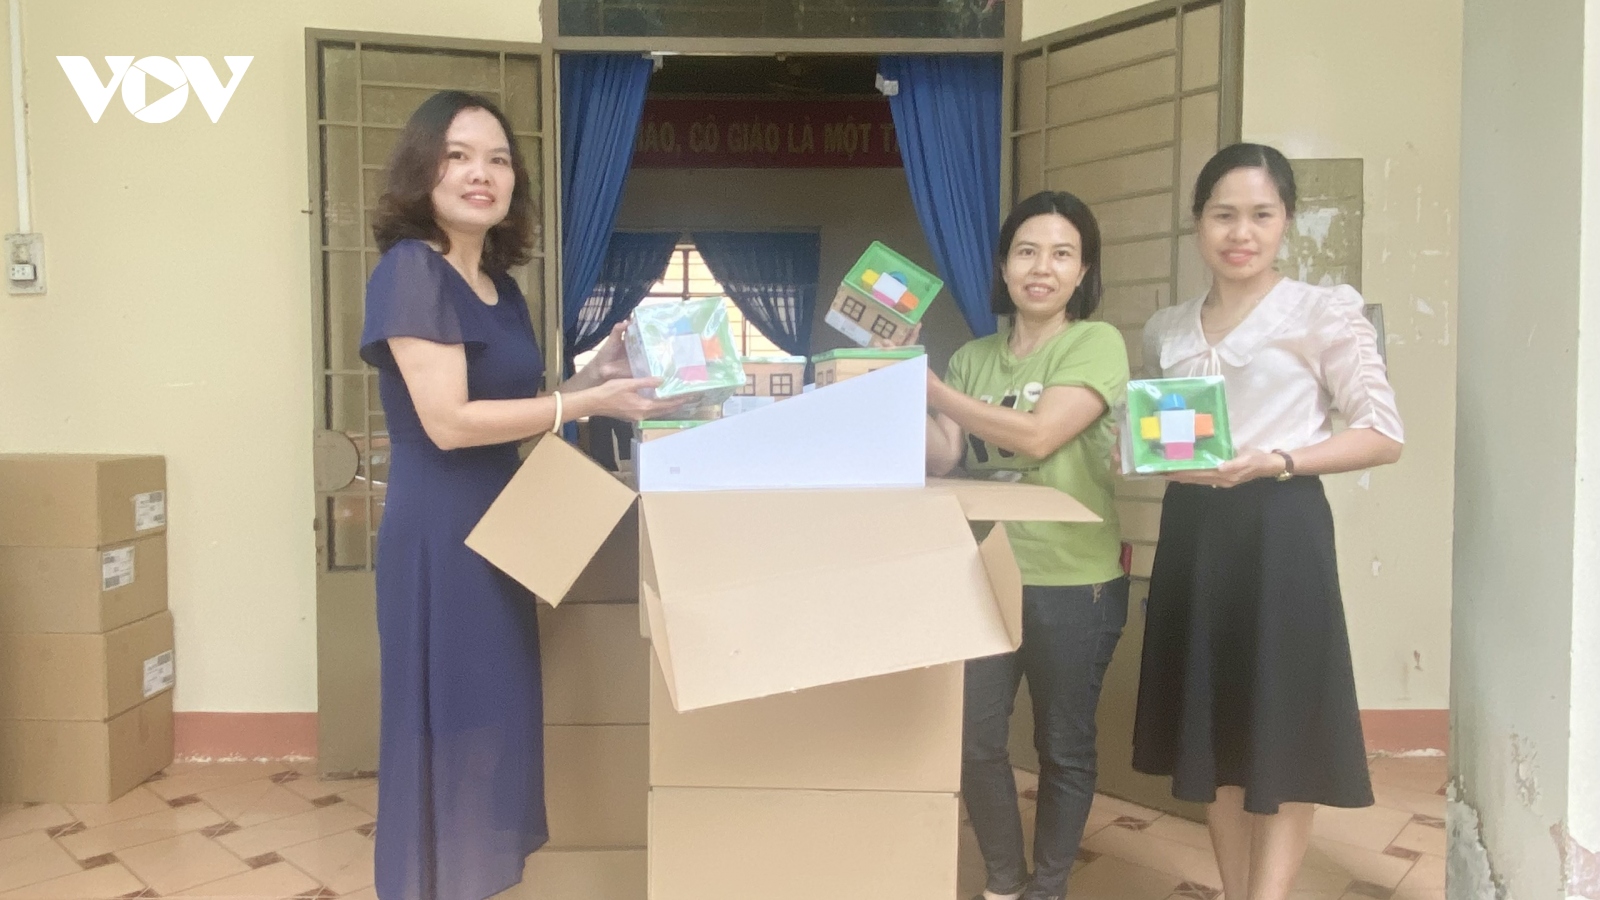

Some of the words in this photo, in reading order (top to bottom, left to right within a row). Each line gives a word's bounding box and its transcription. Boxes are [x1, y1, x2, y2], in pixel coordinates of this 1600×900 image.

[690, 114, 720, 153] CÔ
[728, 114, 780, 153] GIÁO
[786, 116, 815, 153] LÀ
[824, 115, 872, 161] MỘT
[878, 121, 899, 153] T
